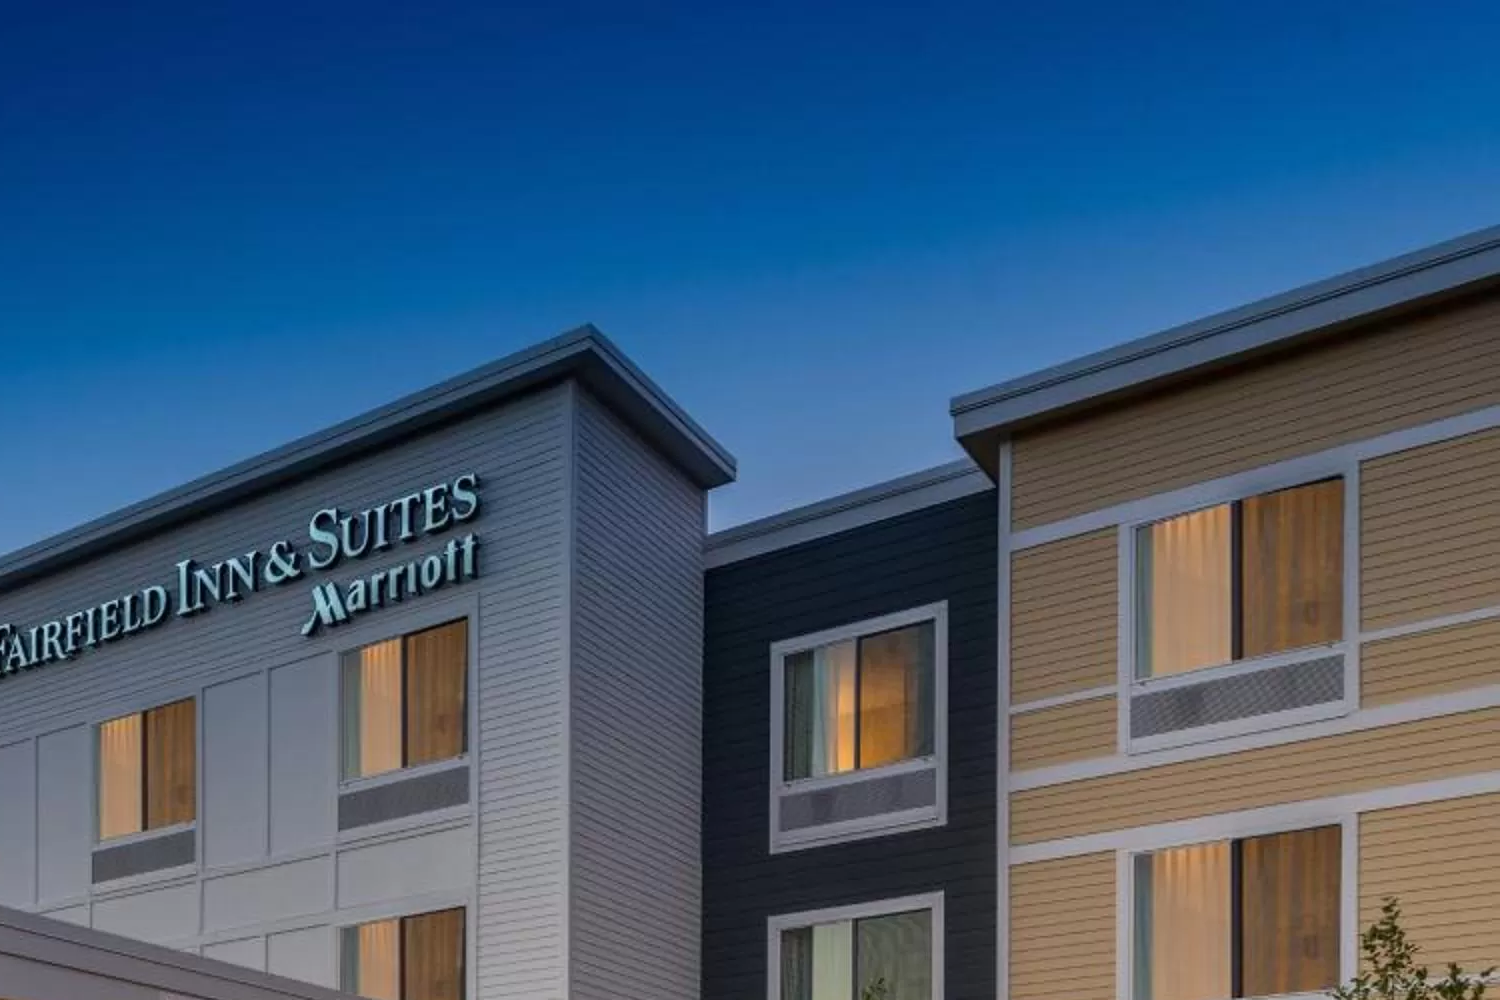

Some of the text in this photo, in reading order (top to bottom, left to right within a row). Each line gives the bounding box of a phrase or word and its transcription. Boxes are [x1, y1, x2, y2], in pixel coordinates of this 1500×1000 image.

[176, 559, 261, 617] INN
[264, 540, 301, 584] &
[307, 473, 481, 570] SUITES
[301, 533, 480, 636] Marriott
